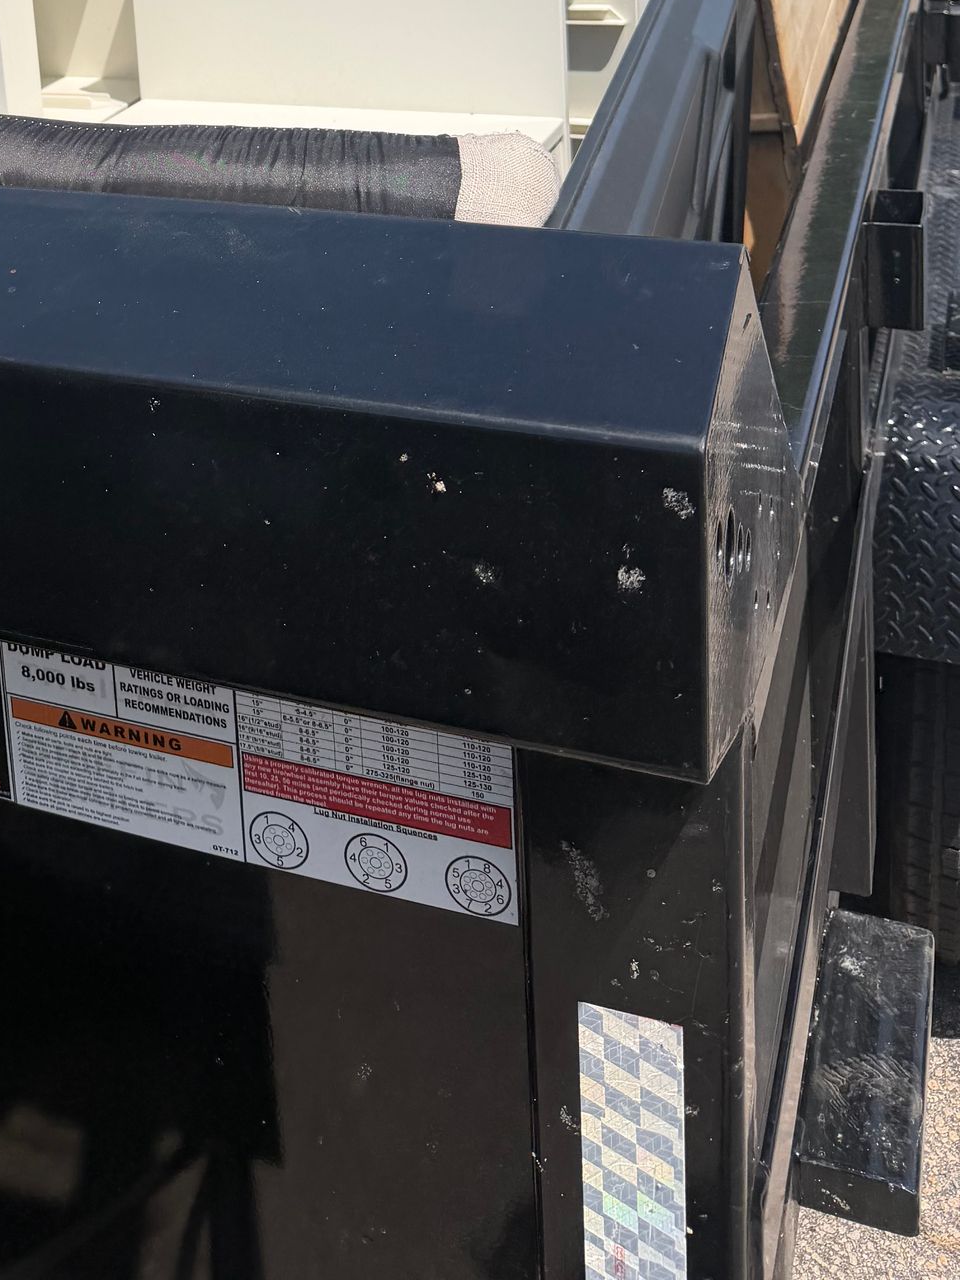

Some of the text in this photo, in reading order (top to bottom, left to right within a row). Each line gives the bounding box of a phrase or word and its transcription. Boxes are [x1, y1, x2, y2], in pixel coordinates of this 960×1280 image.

[20, 664, 95, 692] 8,000 lbs
[129, 668, 216, 695] VEHICLE WEIGHT
[119, 681, 229, 714] RATINGS OR LOADING
[124, 697, 226, 729] RECOMMENDATIONS
[81, 717, 181, 752] WARNING
[381, 726, 408, 737] 100-120
[462, 741, 490, 753] 110-120
[381, 735, 409, 746] 100-120
[463, 751, 491, 762] 110-120
[382, 744, 409, 755] 100-120
[463, 760, 491, 772] 110-120
[382, 754, 409, 764] 110-120
[463, 770, 491, 781] 125-130
[382, 763, 410, 774] 125-120
[463, 779, 491, 791] 125-130
[243, 753, 262, 764] Using
[270, 760, 298, 772] properly
[300, 766, 334, 778] calibrated
[336, 773, 359, 785] torque
[360, 779, 389, 790] wrench,
[391, 785, 400, 793] all
[401, 787, 413, 796] the
[415, 790, 426, 800] lug
[428, 793, 444, 802] nuts
[446, 797, 478, 809] installed
[480, 804, 496, 813] with
[420, 780, 434, 790] nut)
[471, 790, 484, 798] 150
[264, 814, 268, 824] 1
[313, 807, 437, 842] Lug Nut Installation Squences
[288, 822, 295, 832] 4
[254, 833, 261, 844] 3
[360, 836, 366, 847] 6
[296, 847, 303, 858] 2
[384, 842, 388, 852] 1
[276, 856, 283, 866] 5
[349, 852, 356, 862] 4
[395, 862, 402, 873] 3
[464, 859, 470, 869] 1
[483, 862, 490, 874] 8
[452, 867, 459, 878] 5
[362, 873, 369, 884] 2
[384, 878, 391, 888] 5
[496, 878, 504, 889] 4
[452, 883, 460, 894] 3
[496, 894, 504, 904] 6
[484, 902, 491, 913] 2
